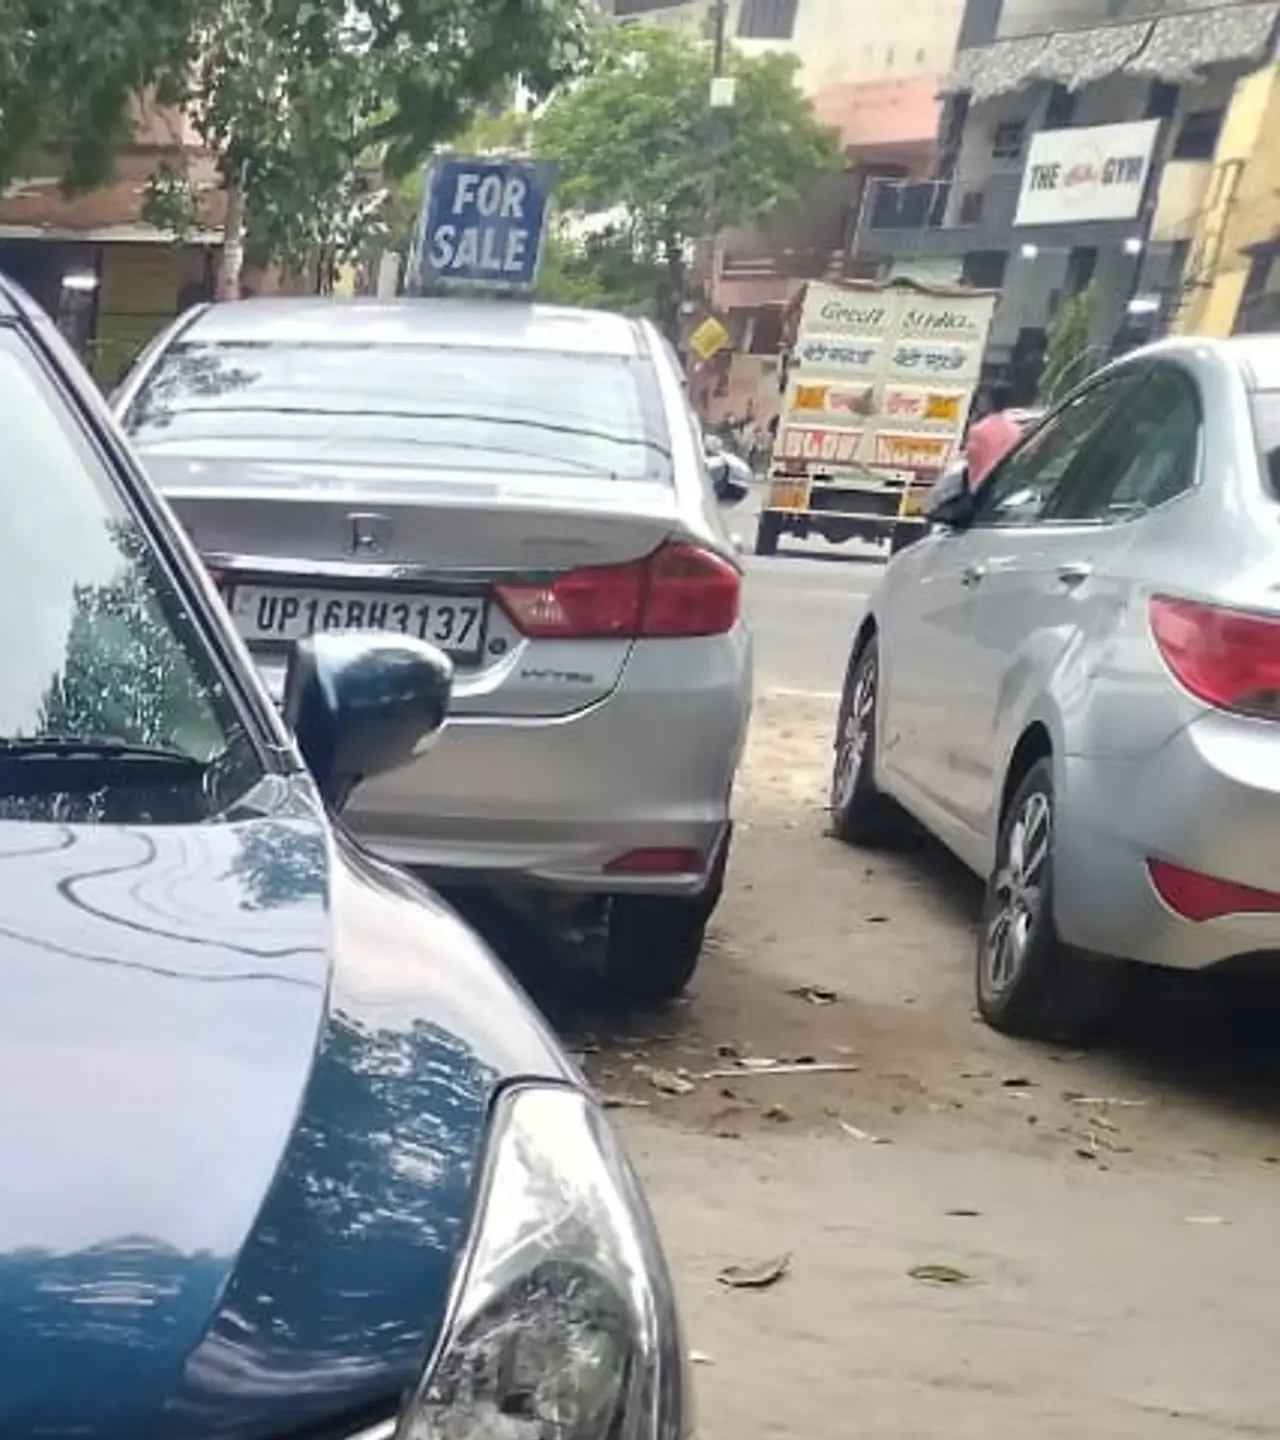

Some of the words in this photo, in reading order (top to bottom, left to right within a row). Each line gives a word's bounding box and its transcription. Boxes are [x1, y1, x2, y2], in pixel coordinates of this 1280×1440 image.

[452, 173, 526, 218] FOR
[1029, 161, 1062, 191] THE
[1100, 155, 1145, 186] GYM
[428, 224, 529, 271] SALE
